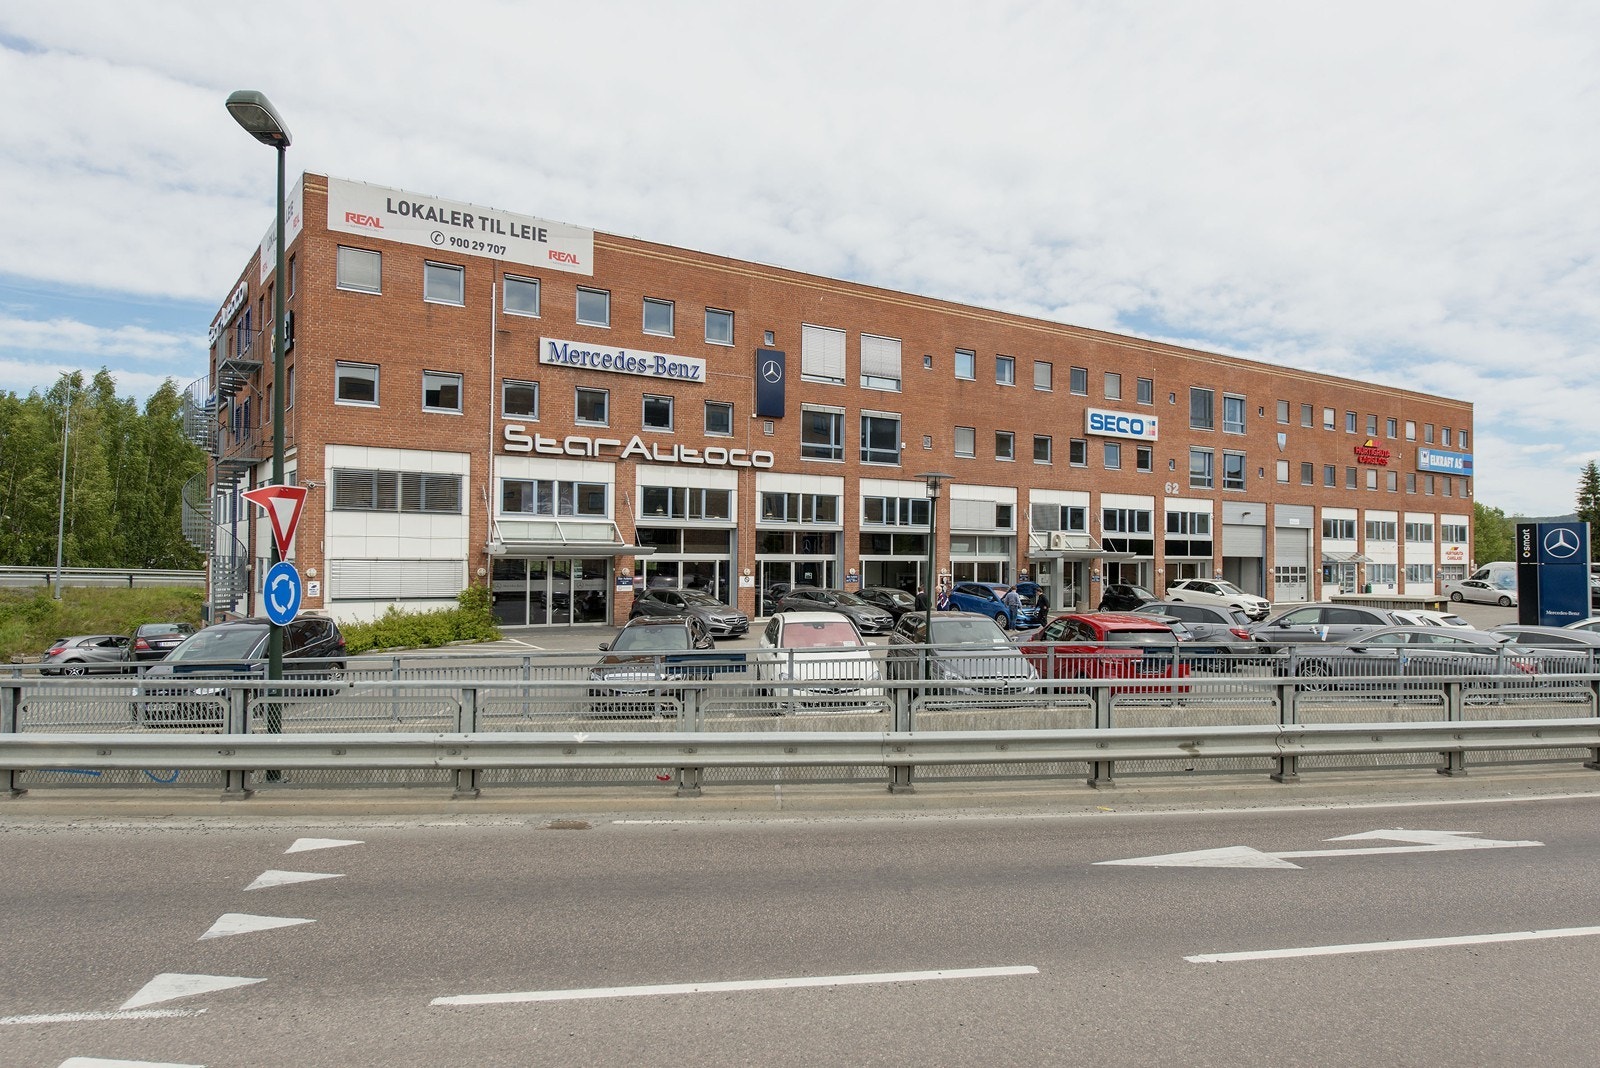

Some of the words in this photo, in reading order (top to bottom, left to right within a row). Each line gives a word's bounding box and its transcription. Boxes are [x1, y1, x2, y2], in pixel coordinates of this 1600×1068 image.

[345, 211, 384, 229] REAL
[386, 197, 475, 229] LOKALER
[478, 215, 506, 235] TIL
[510, 222, 548, 243] LEIE
[449, 236, 470, 249] 900
[472, 240, 484, 251] 29
[487, 243, 507, 256] 707
[548, 249, 580, 265] REAL
[547, 340, 701, 380] Mercedes-Benz
[1090, 412, 1144, 435] SECO
[504, 424, 775, 468] StarAutoco
[1429, 454, 1454, 469] ELKRAFT
[1454, 457, 1463, 469] AS
[1164, 482, 1179, 495] 62
[1522, 528, 1531, 551] smart
